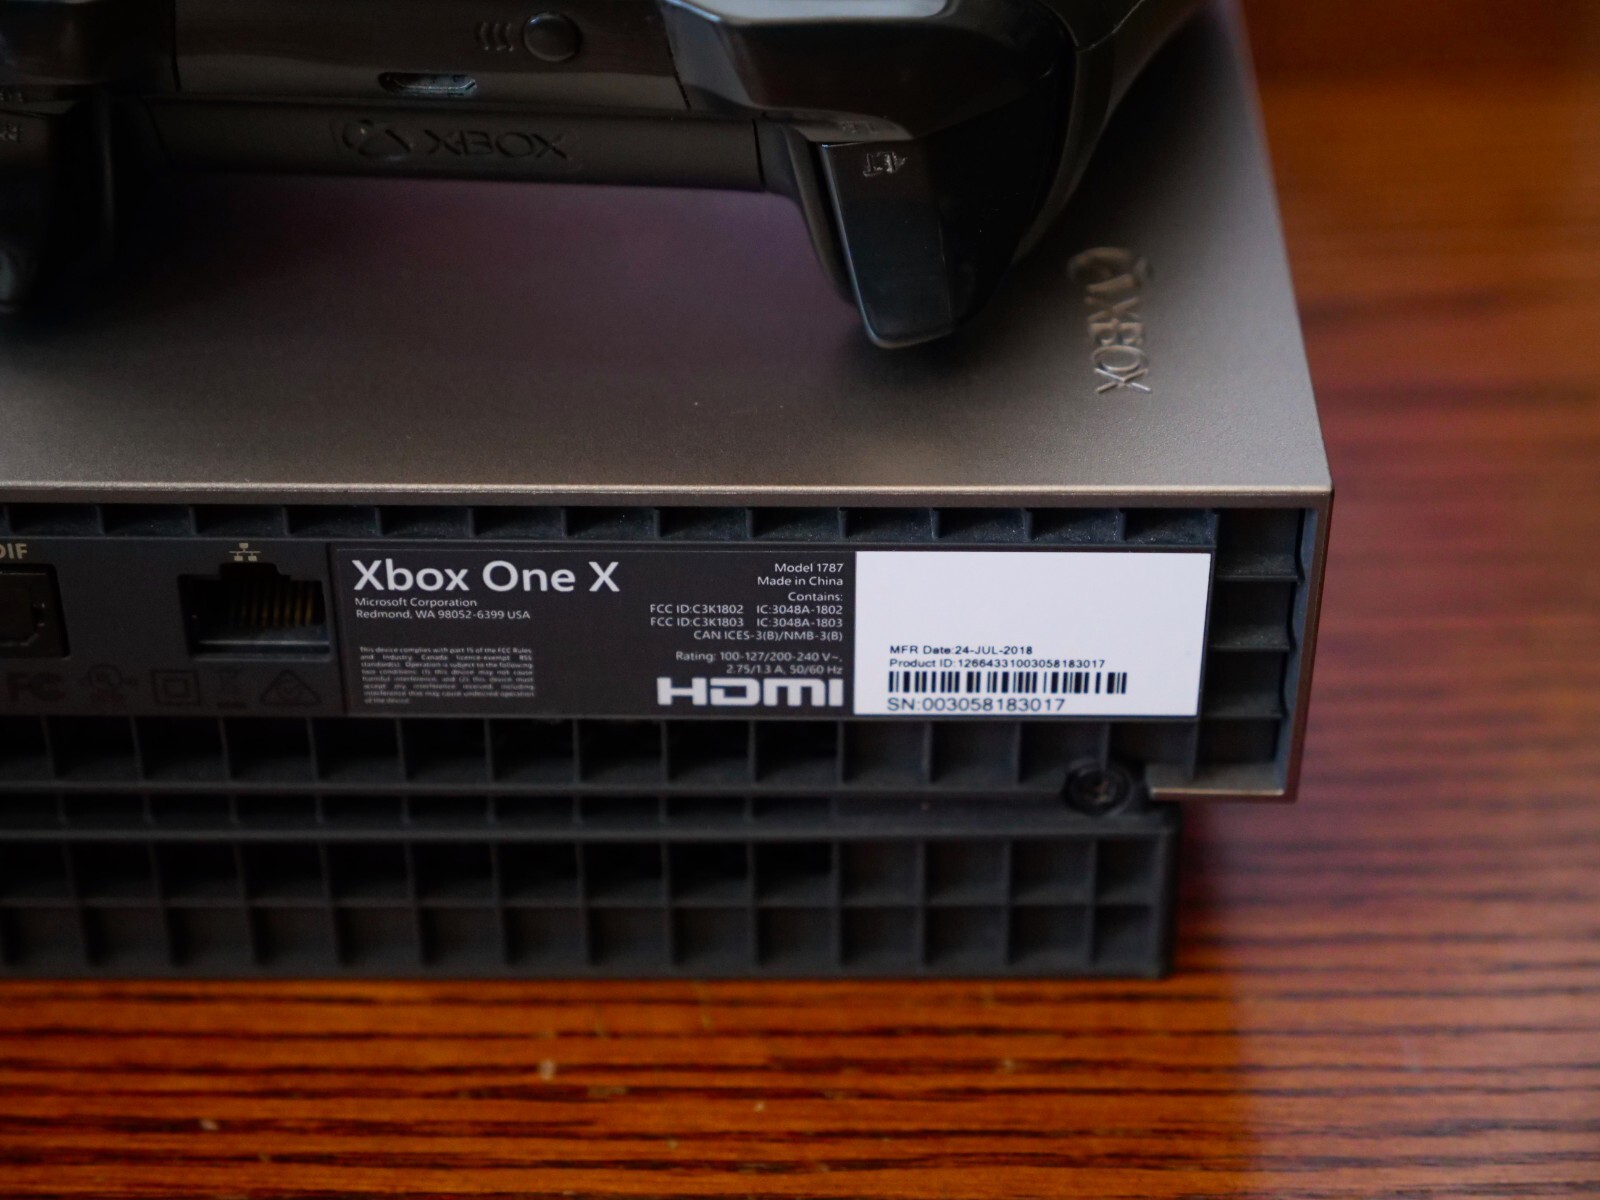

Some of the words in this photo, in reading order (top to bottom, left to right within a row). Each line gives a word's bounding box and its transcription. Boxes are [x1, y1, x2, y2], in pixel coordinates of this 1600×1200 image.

[774, 563, 813, 573] Model
[817, 564, 844, 573] 1787
[352, 558, 470, 592] Xbox
[482, 560, 576, 592] One
[588, 561, 620, 592] X
[757, 576, 792, 586] Made
[794, 576, 806, 586] in
[808, 576, 844, 586] China
[788, 592, 843, 602] Contains:
[354, 598, 407, 607] Microsoft
[410, 598, 478, 609] Corporation
[650, 604, 672, 614] FCC
[676, 604, 744, 614] ID:C3K1802
[756, 604, 843, 614] IC:3048A-1802
[414, 610, 435, 620] WA
[438, 610, 504, 620] 98052-6399
[508, 610, 530, 620] USA
[650, 617, 673, 627] FCC
[676, 617, 744, 627] ID:C3K1803
[756, 618, 843, 628] IC:3048A-1803
[694, 630, 720, 640] CAN
[890, 646, 918, 655] MFR
[923, 646, 1033, 655] Date:24-JUL-2018
[676, 652, 716, 662] Rating:
[720, 652, 820, 662] 100-127/200-240
[890, 658, 936, 668] Product
[790, 666, 824, 674] 50/60
[827, 666, 843, 674] Hz
[656, 677, 844, 706] HDMI
[887, 698, 1066, 712] SN:003058183017
